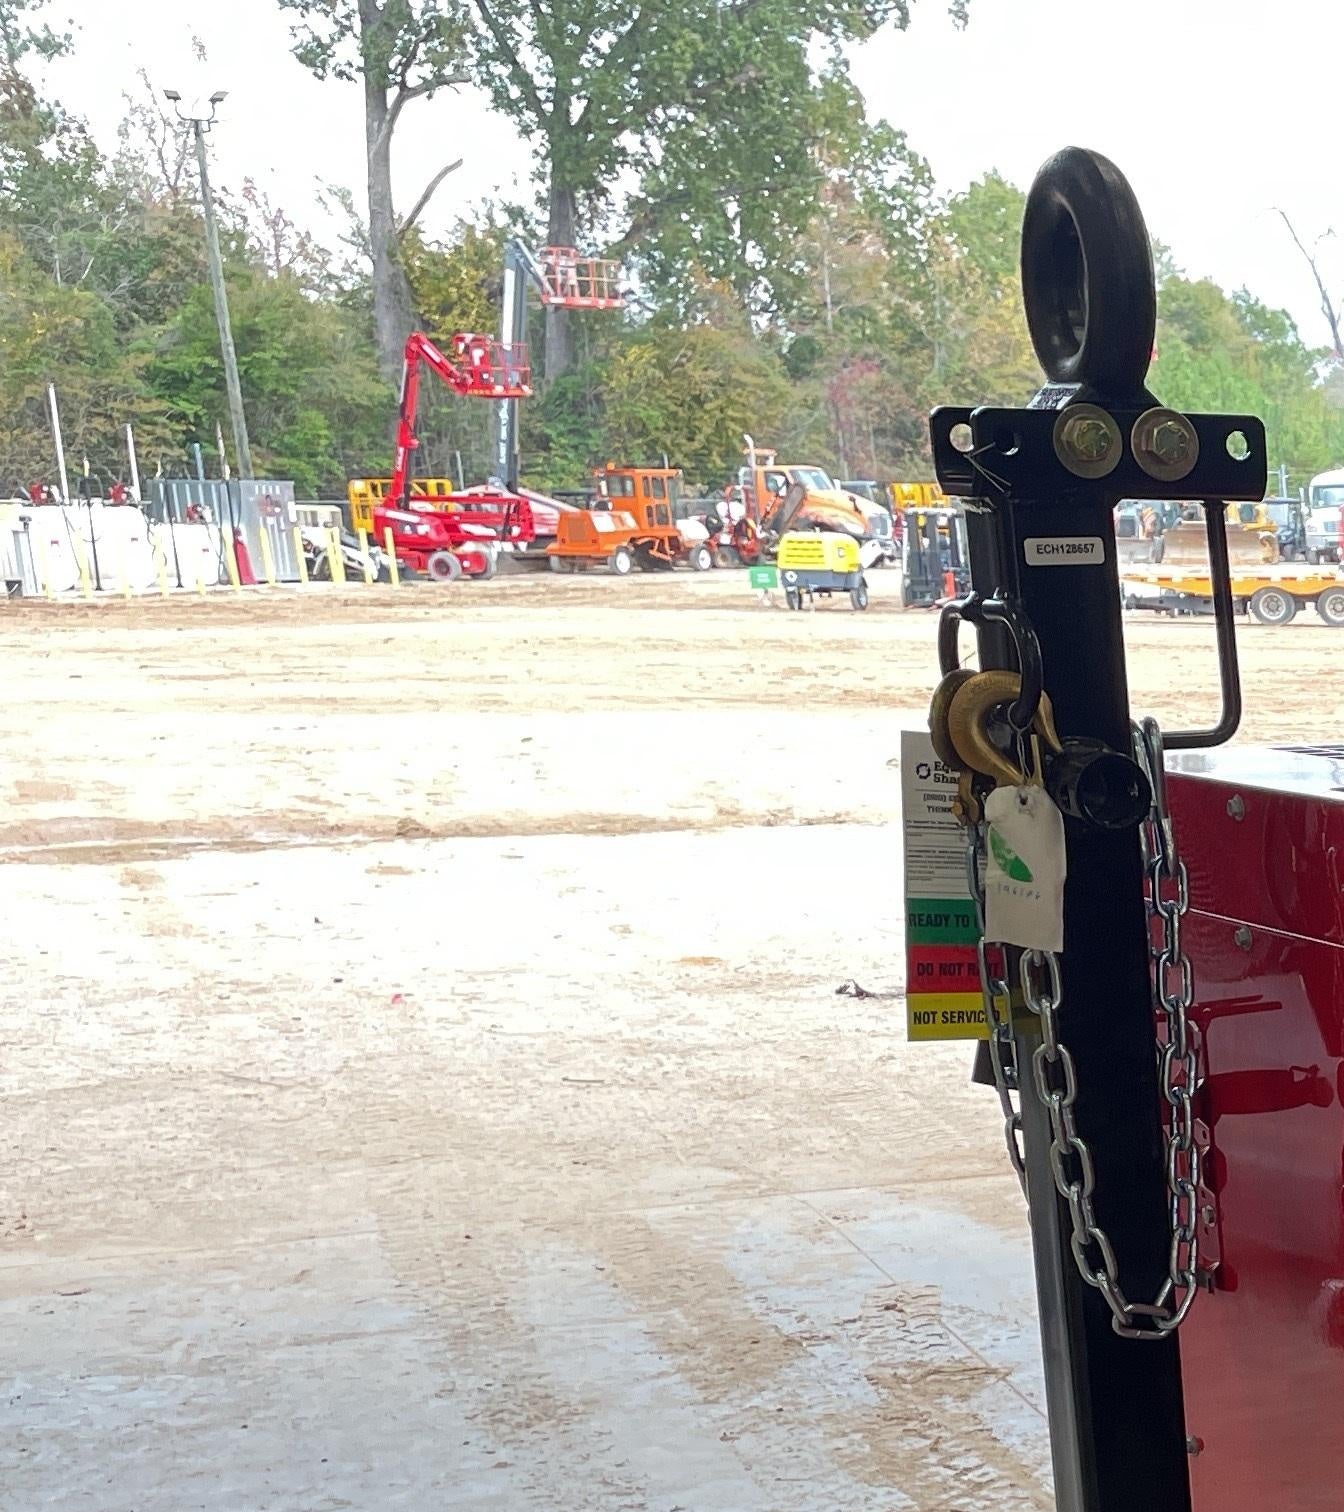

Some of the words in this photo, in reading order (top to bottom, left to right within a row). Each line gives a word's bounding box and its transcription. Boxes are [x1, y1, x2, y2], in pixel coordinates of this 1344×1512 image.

[908, 913, 950, 928] READY
[955, 914, 970, 927] TO
[916, 962, 934, 977] DO
[938, 962, 963, 977] NOT
[913, 1010, 938, 1025] NOT
